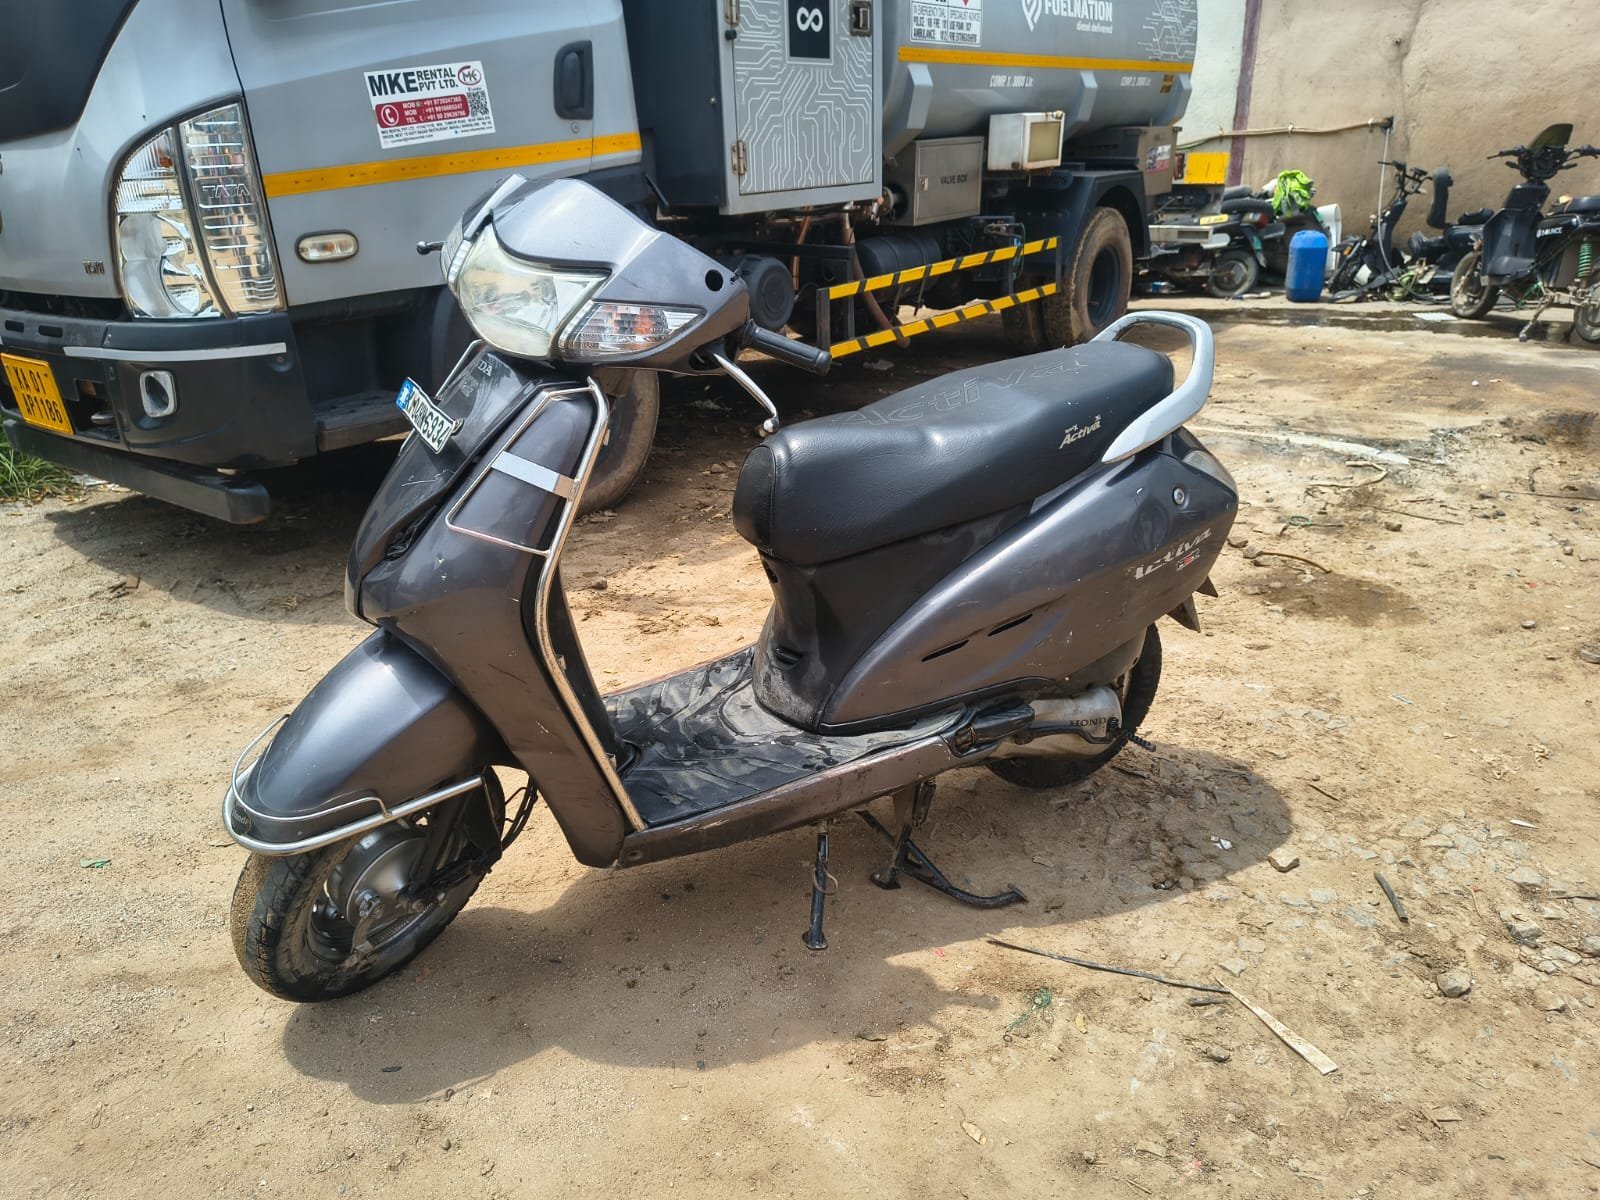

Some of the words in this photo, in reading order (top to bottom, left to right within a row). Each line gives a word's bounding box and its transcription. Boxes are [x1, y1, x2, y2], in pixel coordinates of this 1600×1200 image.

[1044, 0, 1112, 22] FUELNATION
[416, 67, 456, 81] RENTAL
[368, 71, 418, 96] MKE
[418, 82, 436, 92] PVT
[438, 79, 459, 89] LTD.
[941, 175, 956, 184] VALVE
[957, 173, 968, 183] BOX
[13, 366, 32, 392] KA
[1058, 420, 1101, 450] Activa
[1071, 717, 1108, 728] HOND
